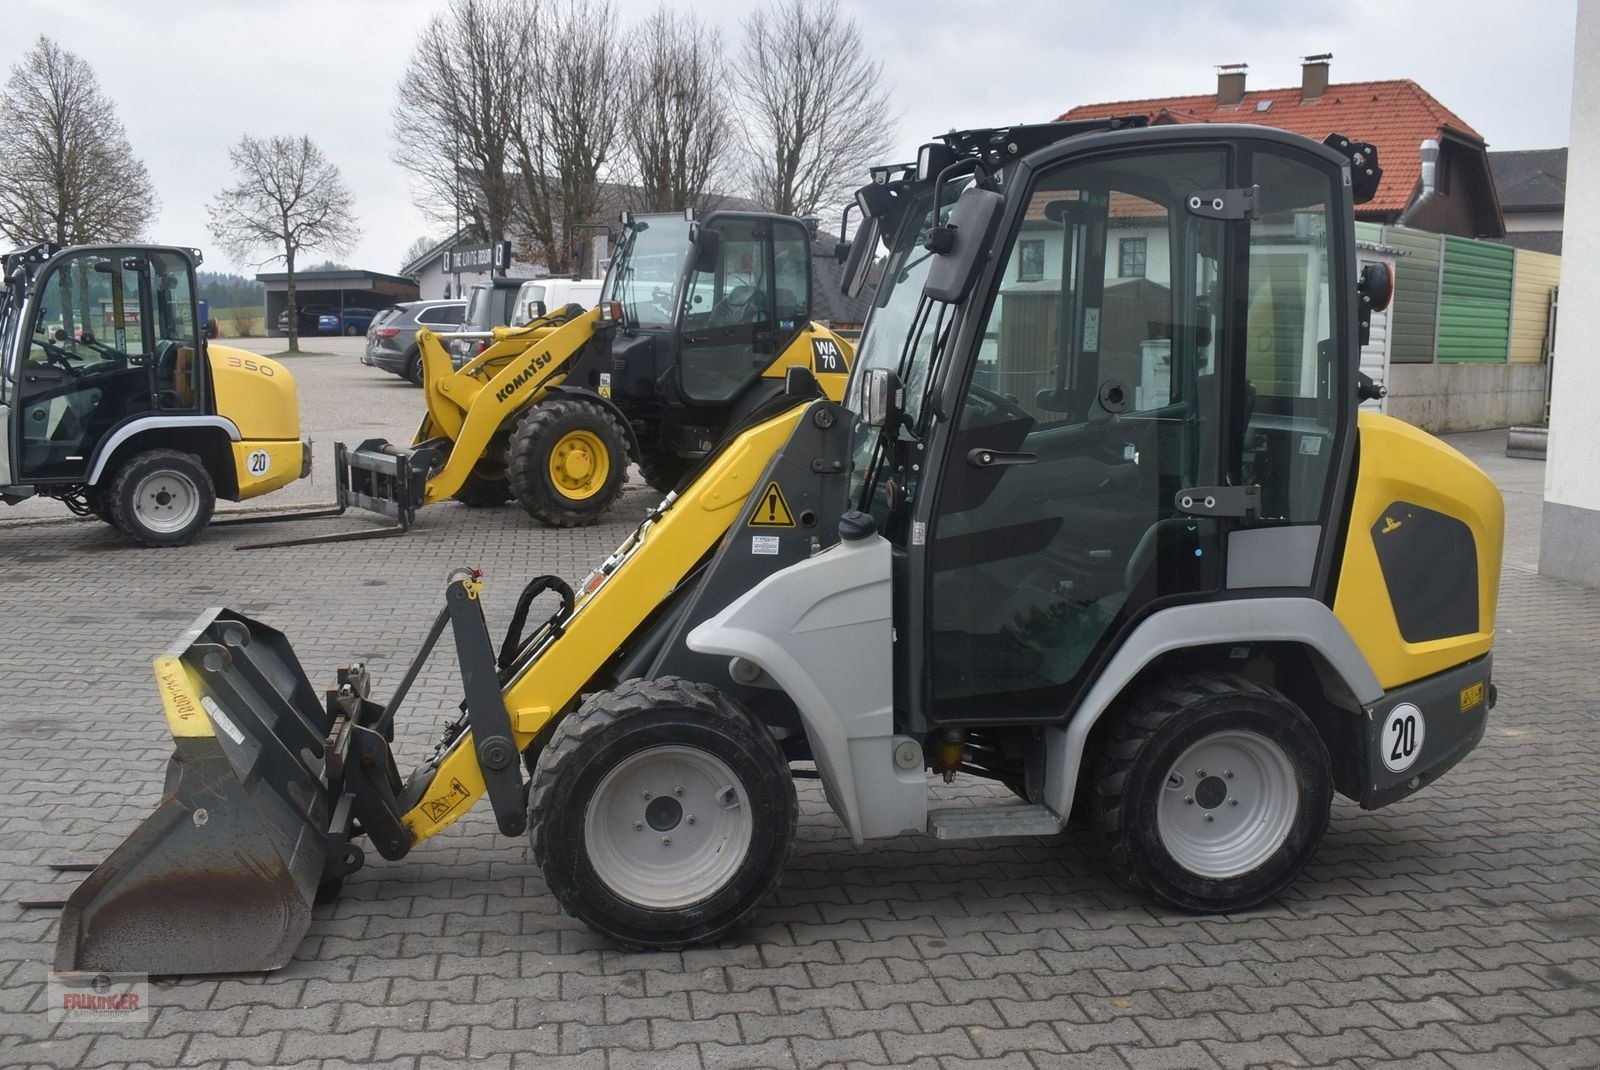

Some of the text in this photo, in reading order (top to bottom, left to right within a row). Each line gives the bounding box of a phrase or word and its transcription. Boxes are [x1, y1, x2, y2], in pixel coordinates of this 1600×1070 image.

[815, 341, 837, 355] WA
[227, 356, 274, 377] 350
[822, 355, 836, 369] 70
[496, 350, 552, 403] KOMATSU
[252, 453, 266, 472] 20
[1391, 715, 1415, 760] 20
